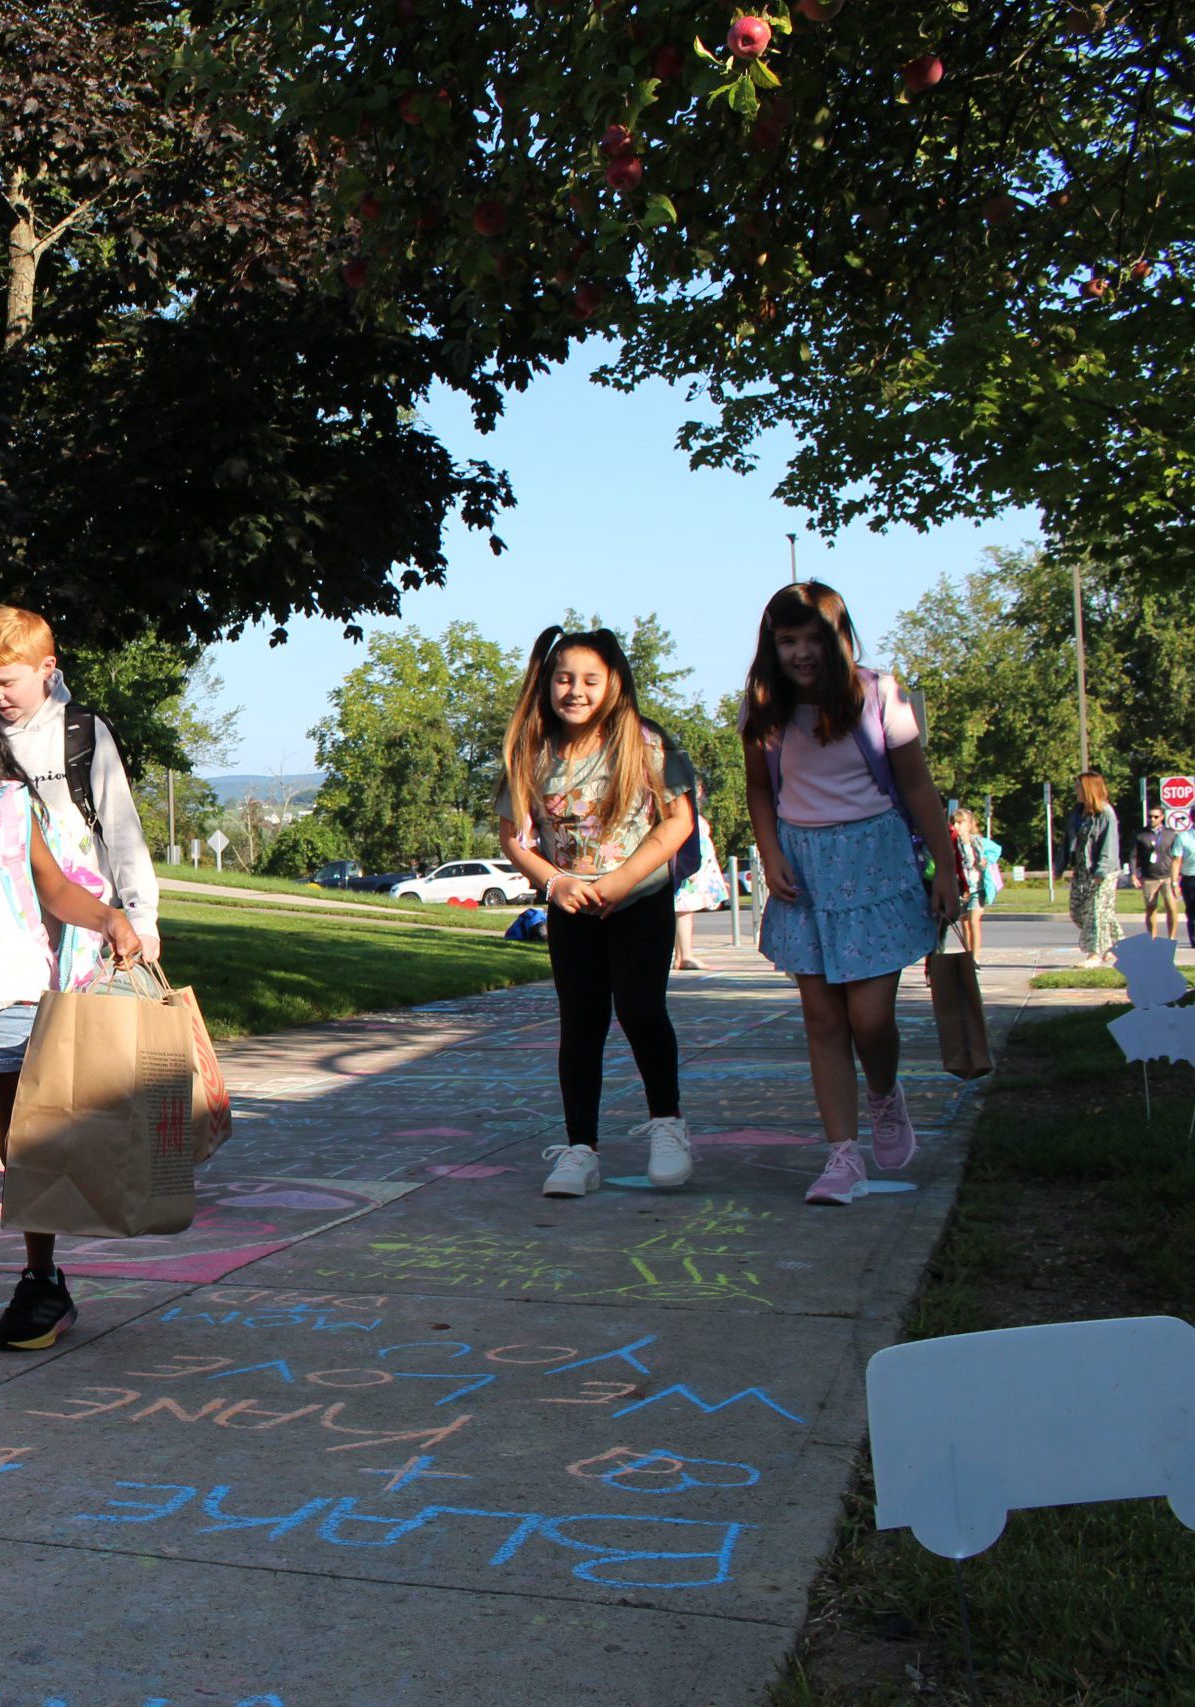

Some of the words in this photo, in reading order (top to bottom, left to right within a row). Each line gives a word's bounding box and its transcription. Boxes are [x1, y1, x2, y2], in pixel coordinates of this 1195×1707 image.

[1163, 786, 1193, 799] STOP
[157, 1307, 383, 1333] MOM
[211, 1290, 389, 1310] DAD
[378, 1334, 657, 1375] YOU
[124, 1355, 495, 1406] LOVE
[25, 1386, 472, 1451] KANE
[536, 1382, 806, 1424] WE
[70, 1482, 758, 1588] BLAKE
